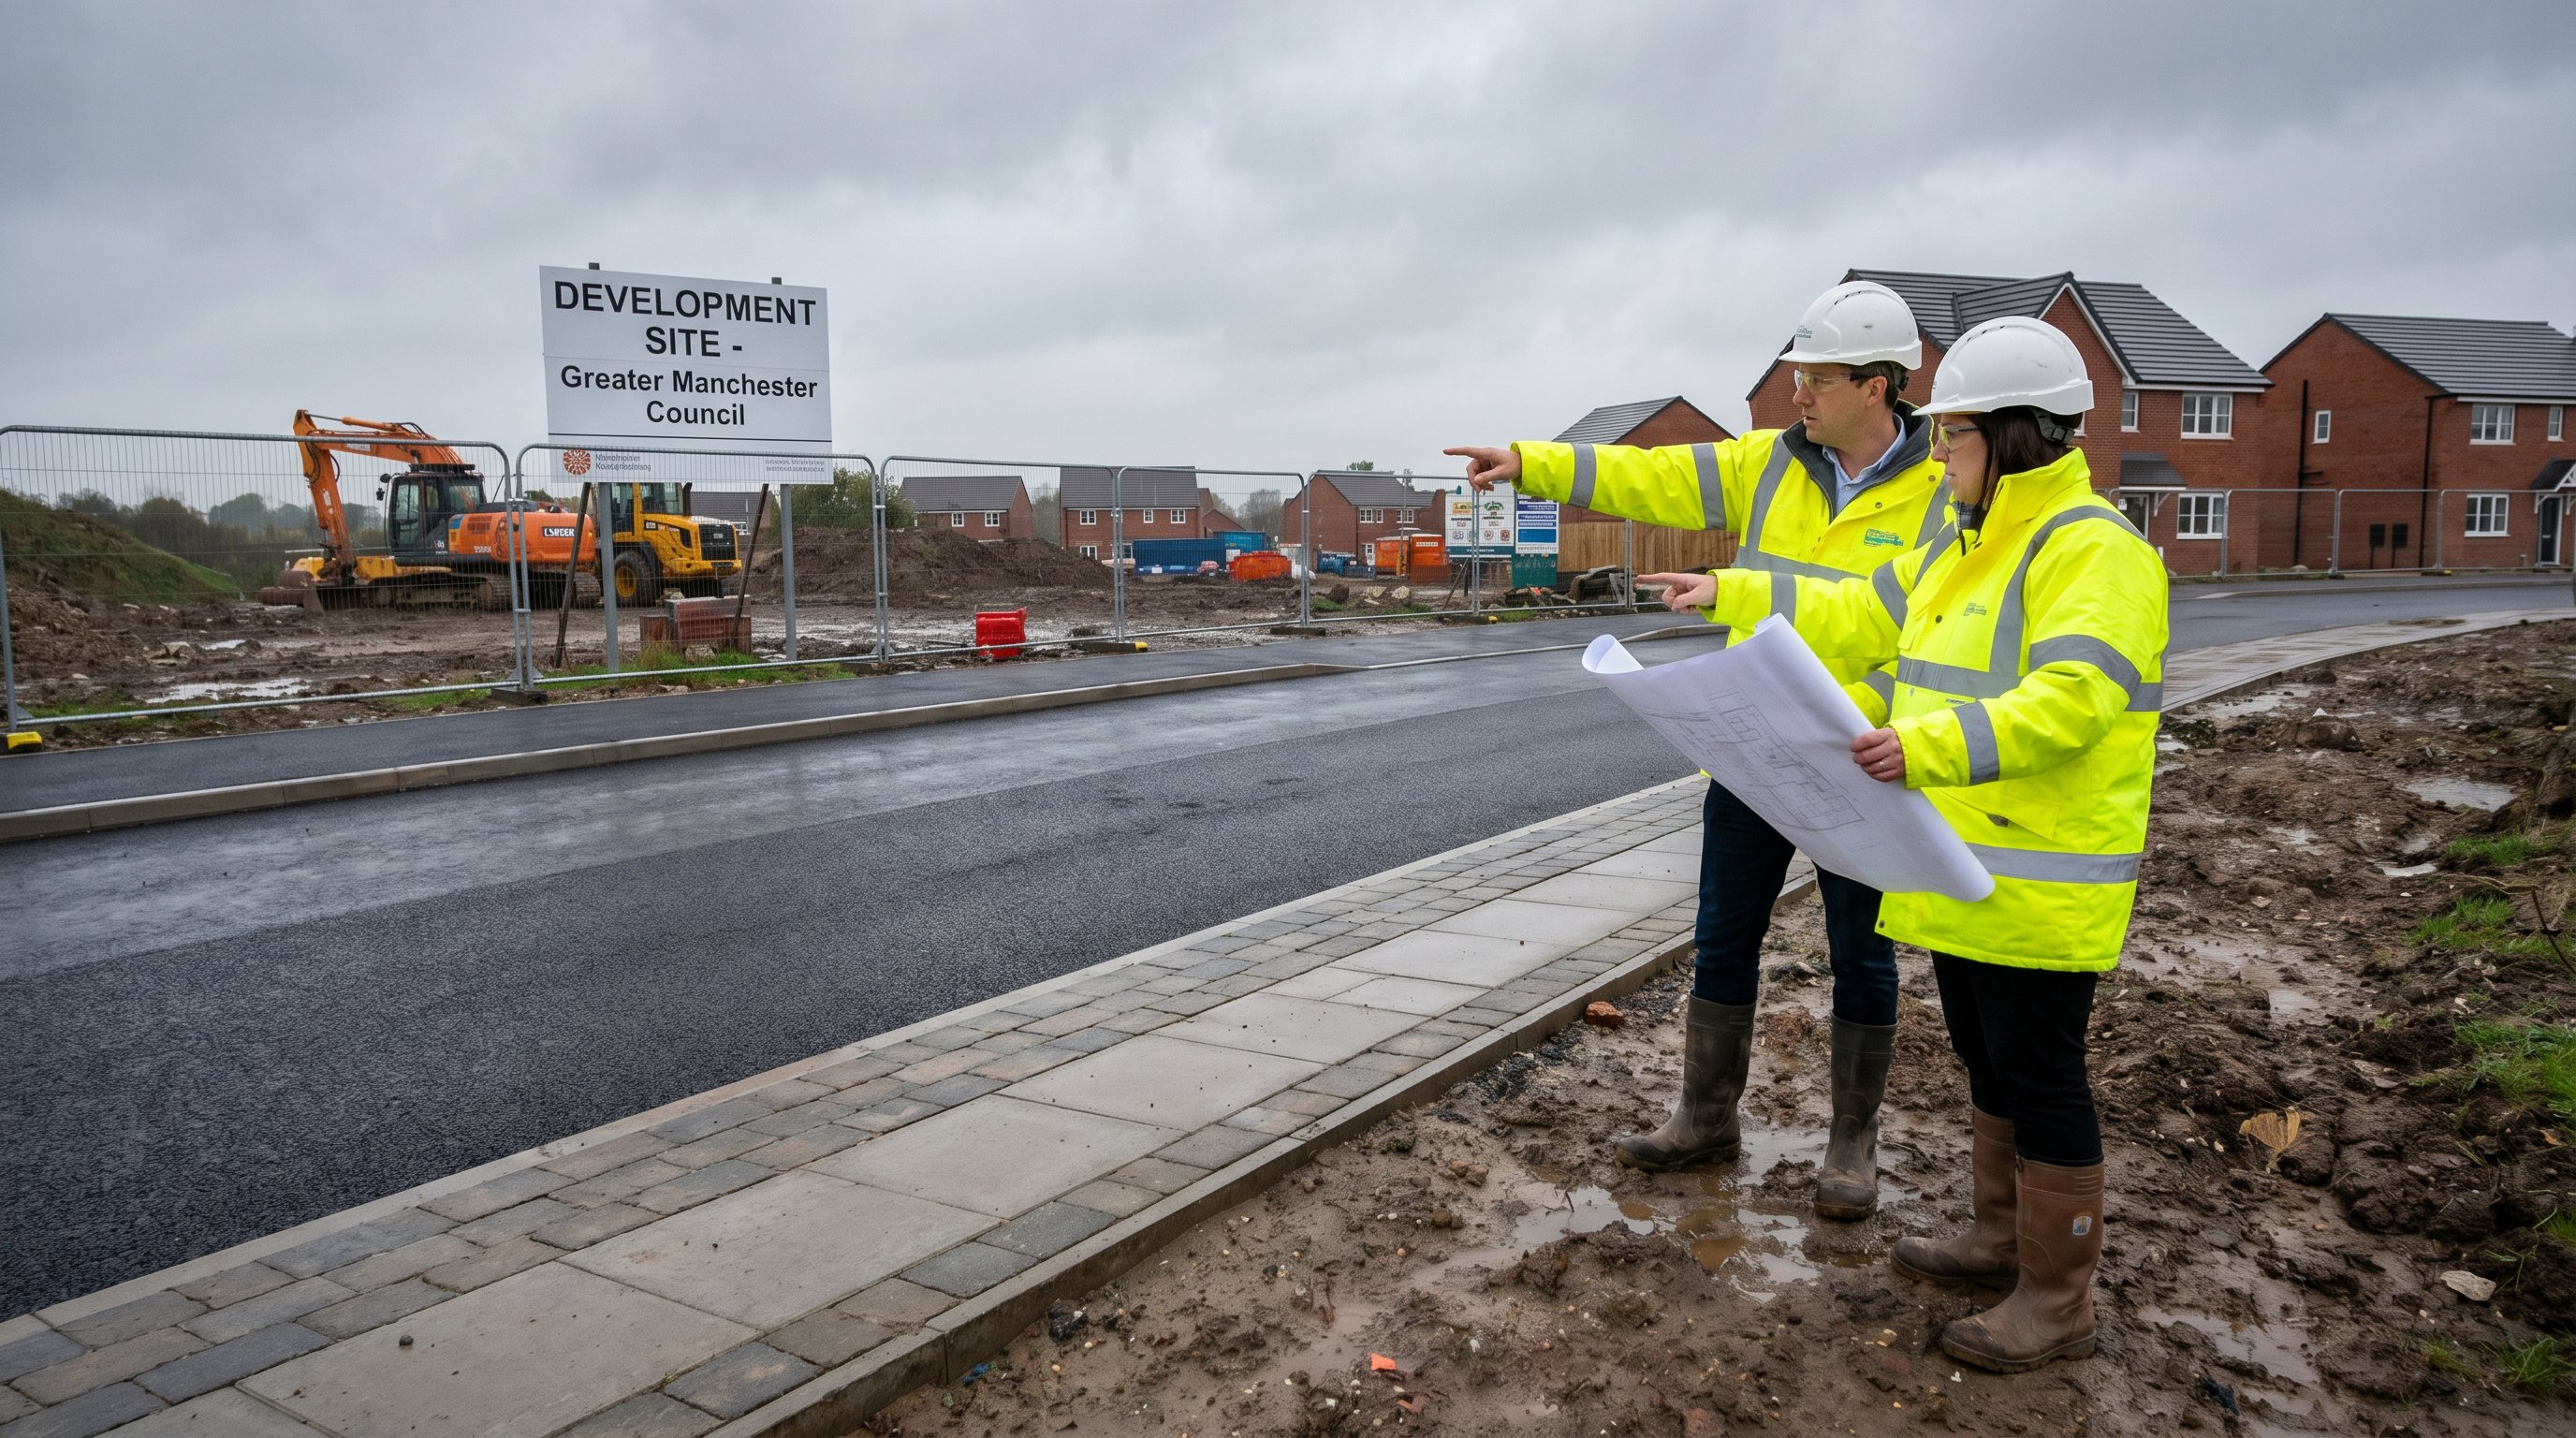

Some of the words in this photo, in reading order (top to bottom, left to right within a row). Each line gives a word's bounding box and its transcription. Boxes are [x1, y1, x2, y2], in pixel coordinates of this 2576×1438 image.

[554, 280, 816, 326] DEVELOPMENT
[645, 326, 721, 358] SITE
[561, 365, 664, 392] Greater
[672, 370, 818, 398] Manchester
[646, 400, 745, 426] Council
